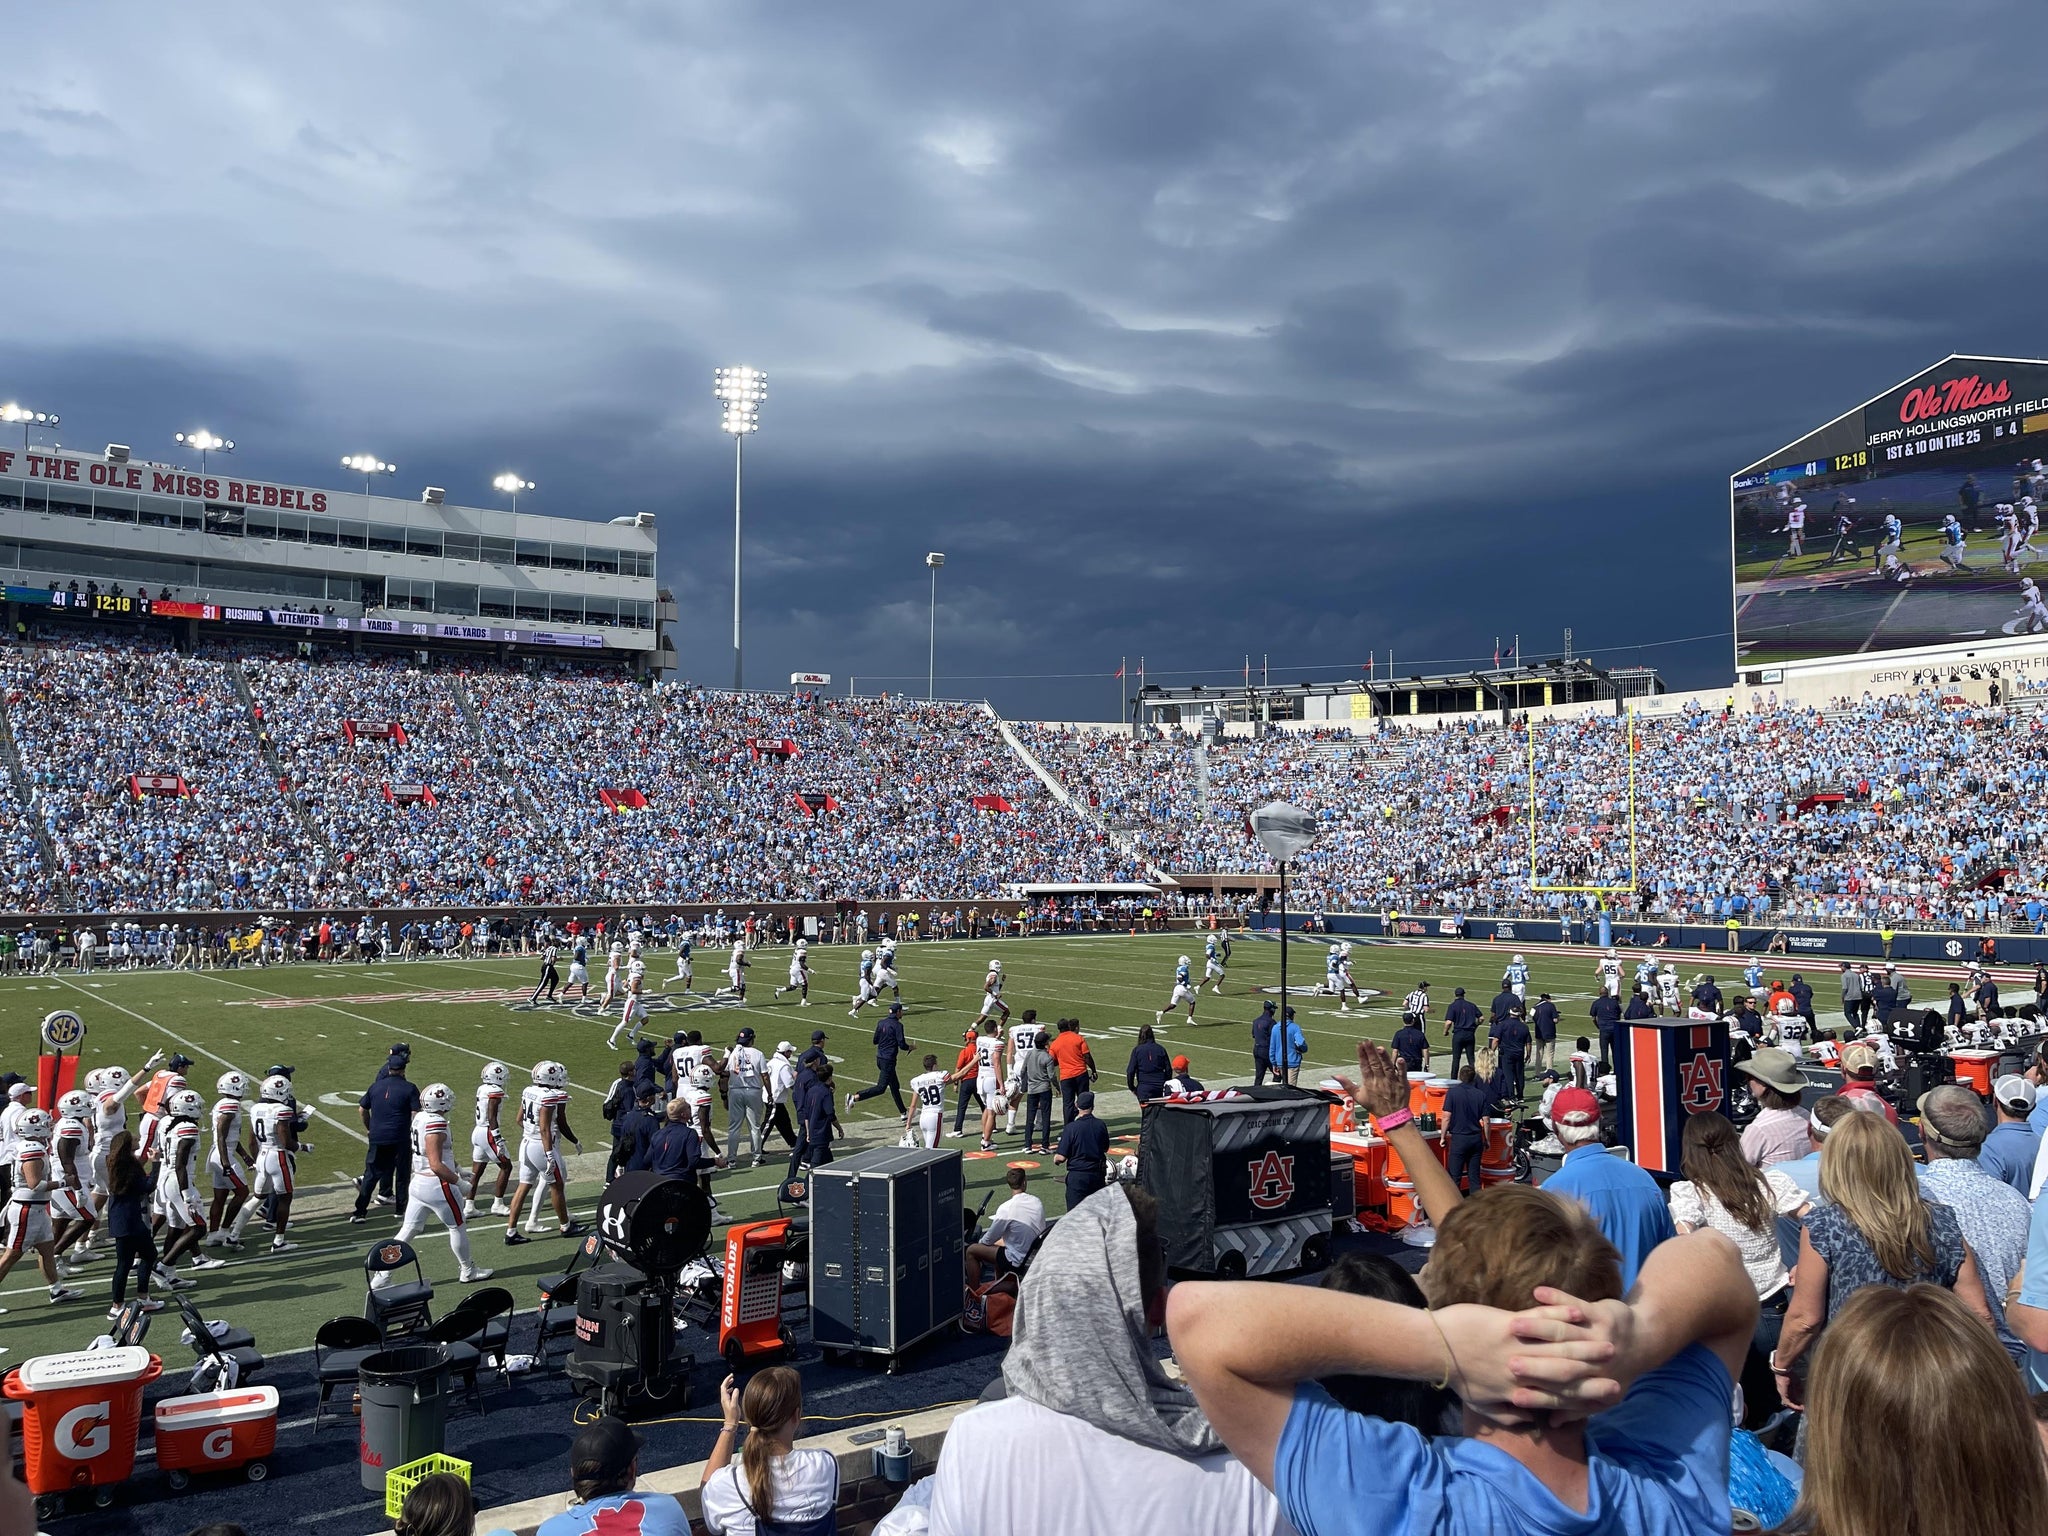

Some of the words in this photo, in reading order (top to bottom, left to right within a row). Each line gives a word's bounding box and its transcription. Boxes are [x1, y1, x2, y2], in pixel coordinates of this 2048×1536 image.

[1900, 384, 1942, 423] Ole
[1941, 375, 2012, 414] Miss
[1866, 428, 1904, 446] JERRY
[1906, 406, 2011, 437] HOLLINGSWORTH
[2014, 397, 2048, 415] FIELD
[2009, 421, 2018, 435] 4
[1886, 446, 1903, 461] 1ST
[1905, 445, 1914, 457] &
[1915, 440, 1927, 454] 10
[1928, 438, 1944, 452] ON
[1945, 433, 1965, 449] THE
[1966, 429, 1981, 444] 25
[1805, 461, 1817, 477] 41
[1835, 451, 1867, 471] 12:18
[26, 455, 80, 482] THE
[89, 464, 142, 490] OLE
[152, 472, 220, 499] MISS
[228, 482, 327, 512] REBELS
[52, 591, 66, 606] 41
[95, 595, 131, 612] 12:18
[202, 605, 216, 620] 31
[224, 607, 264, 623] RUSHING
[277, 611, 321, 627] ATTEMPTS
[336, 617, 349, 630] 39
[367, 620, 393, 632] YARDS
[412, 623, 428, 635] 219
[443, 626, 461, 637] AVG.
[462, 628, 487, 640] YARDS
[1870, 670, 1908, 684] JERRY
[1913, 659, 2029, 679] HOLLINGSWORTH
[1945, 940, 1963, 957] SEC
[1510, 970, 1522, 982] 13
[1604, 964, 1617, 975] 85
[50, 1016, 78, 1042] SEC
[1783, 1026, 1801, 1040] 32
[1016, 1032, 1035, 1049] 57
[676, 1056, 694, 1078] 50
[918, 1084, 941, 1106] 38
[1810, 1081, 1833, 1089] Football
[256, 1118, 267, 1142] 0
[723, 1239, 738, 1328] GATORADE
[45, 1363, 126, 1376] GATORADE
[47, 1354, 126, 1367] GATORADE
[54, 1400, 112, 1460] G
[203, 1428, 233, 1459] G
